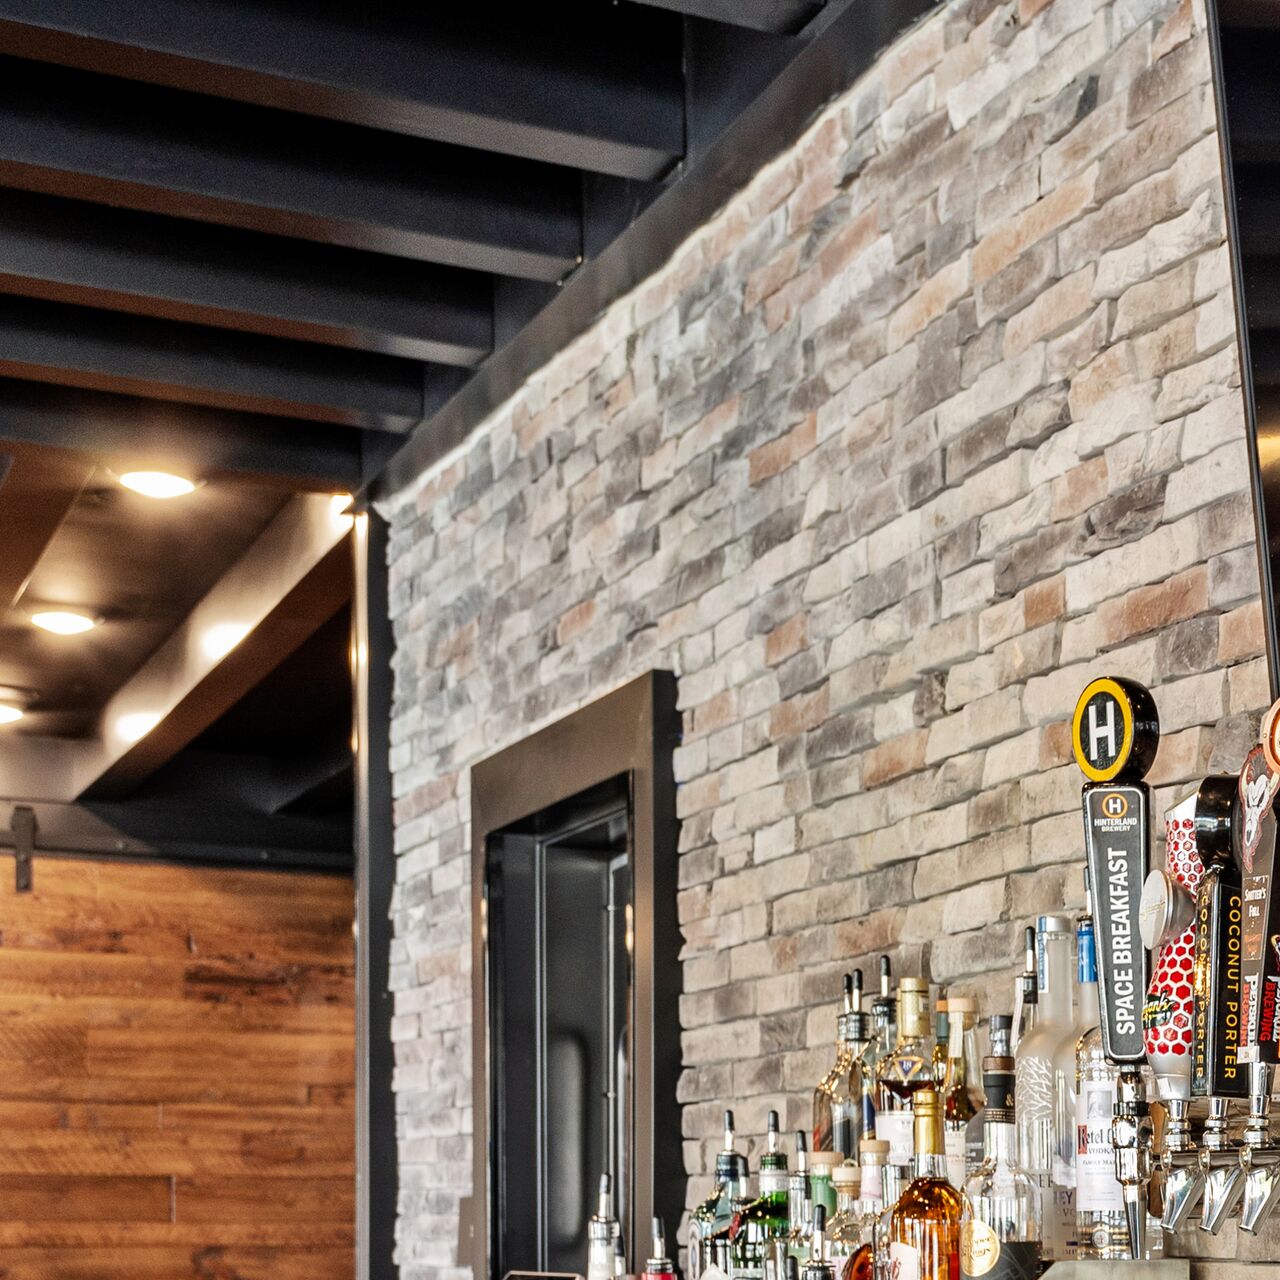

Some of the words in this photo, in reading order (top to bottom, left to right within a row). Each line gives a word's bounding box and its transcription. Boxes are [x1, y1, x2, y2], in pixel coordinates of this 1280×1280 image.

[1088, 700, 1116, 761] H
[1094, 817, 1138, 827] HINTERLAND
[1101, 824, 1131, 832] BREWERY
[1108, 798, 1122, 814] H
[1108, 847, 1133, 965] BREAKFAST
[1226, 895, 1241, 993] COCONUT
[1113, 968, 1136, 1036] SPACE
[1260, 982, 1276, 1041] BREWING
[1223, 1001, 1238, 1080] PORTER
